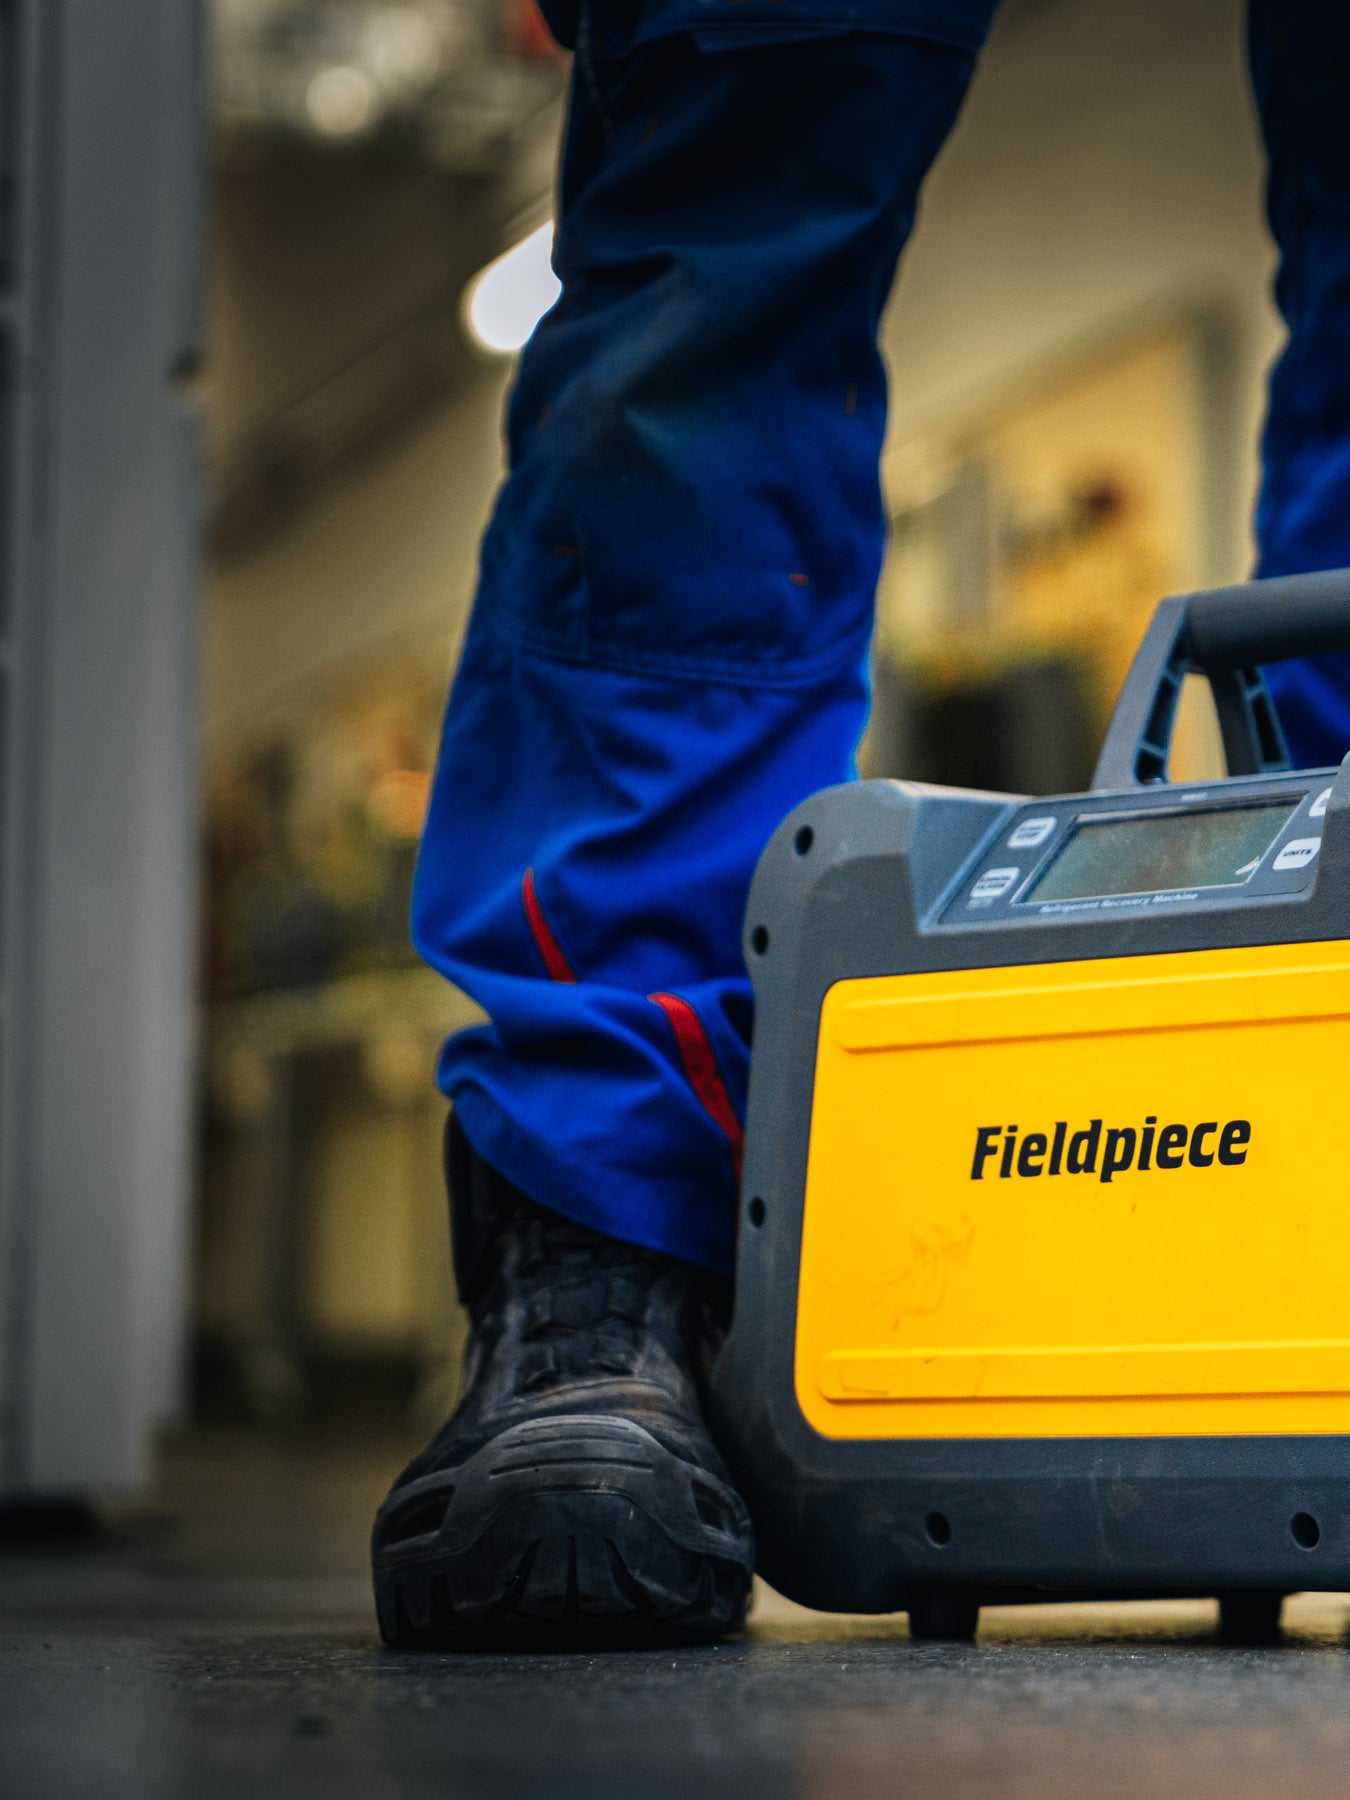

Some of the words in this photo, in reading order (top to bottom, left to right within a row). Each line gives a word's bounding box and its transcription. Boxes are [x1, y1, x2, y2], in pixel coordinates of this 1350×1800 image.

[1282, 848, 1313, 857] UNITS
[1152, 892, 1199, 903] Machine
[970, 1115, 1251, 1183] Fieldpiece
